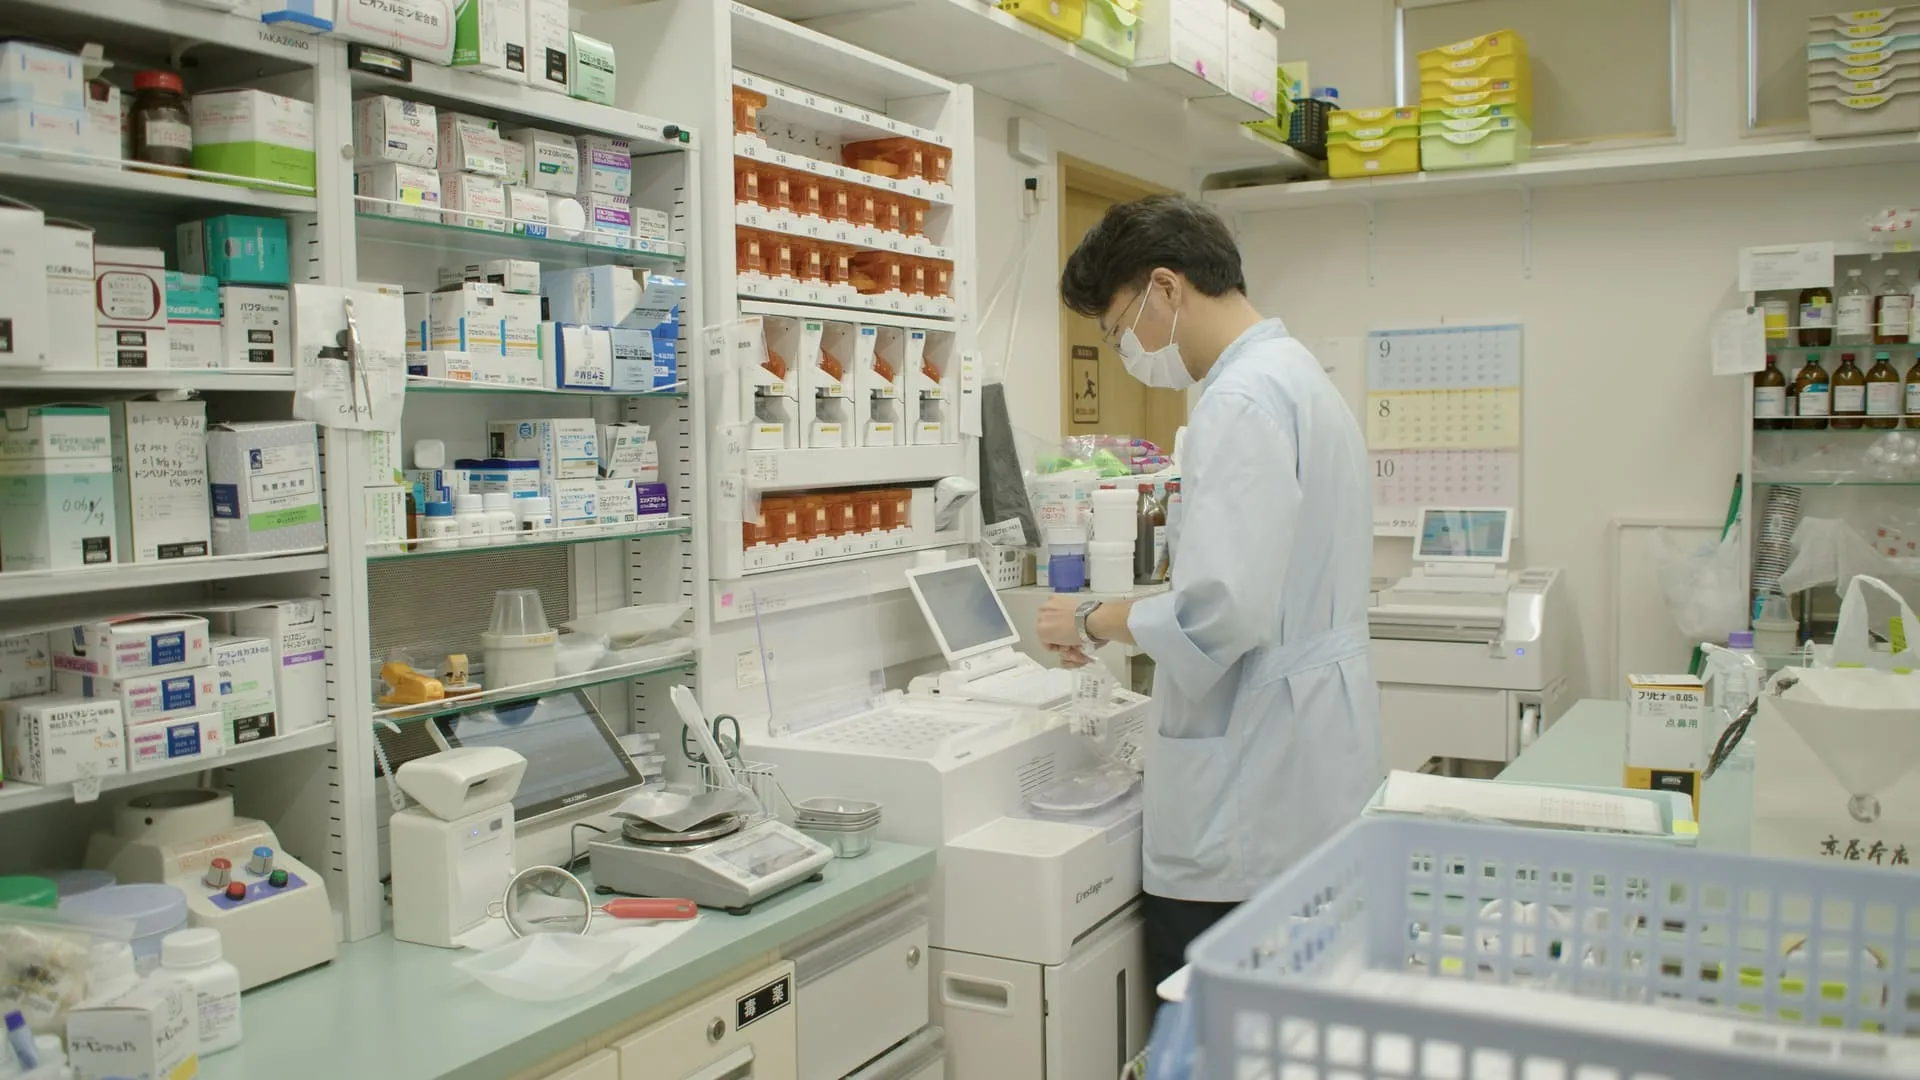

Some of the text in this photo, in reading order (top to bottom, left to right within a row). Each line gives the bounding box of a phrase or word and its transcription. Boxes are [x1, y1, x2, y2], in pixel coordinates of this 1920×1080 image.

[258, 31, 309, 50] TAKAZONO
[1379, 339, 1391, 359] 9
[1378, 399, 1391, 418] 8
[1375, 459, 1394, 478] 10
[1665, 718, 1699, 729] 点鼻用
